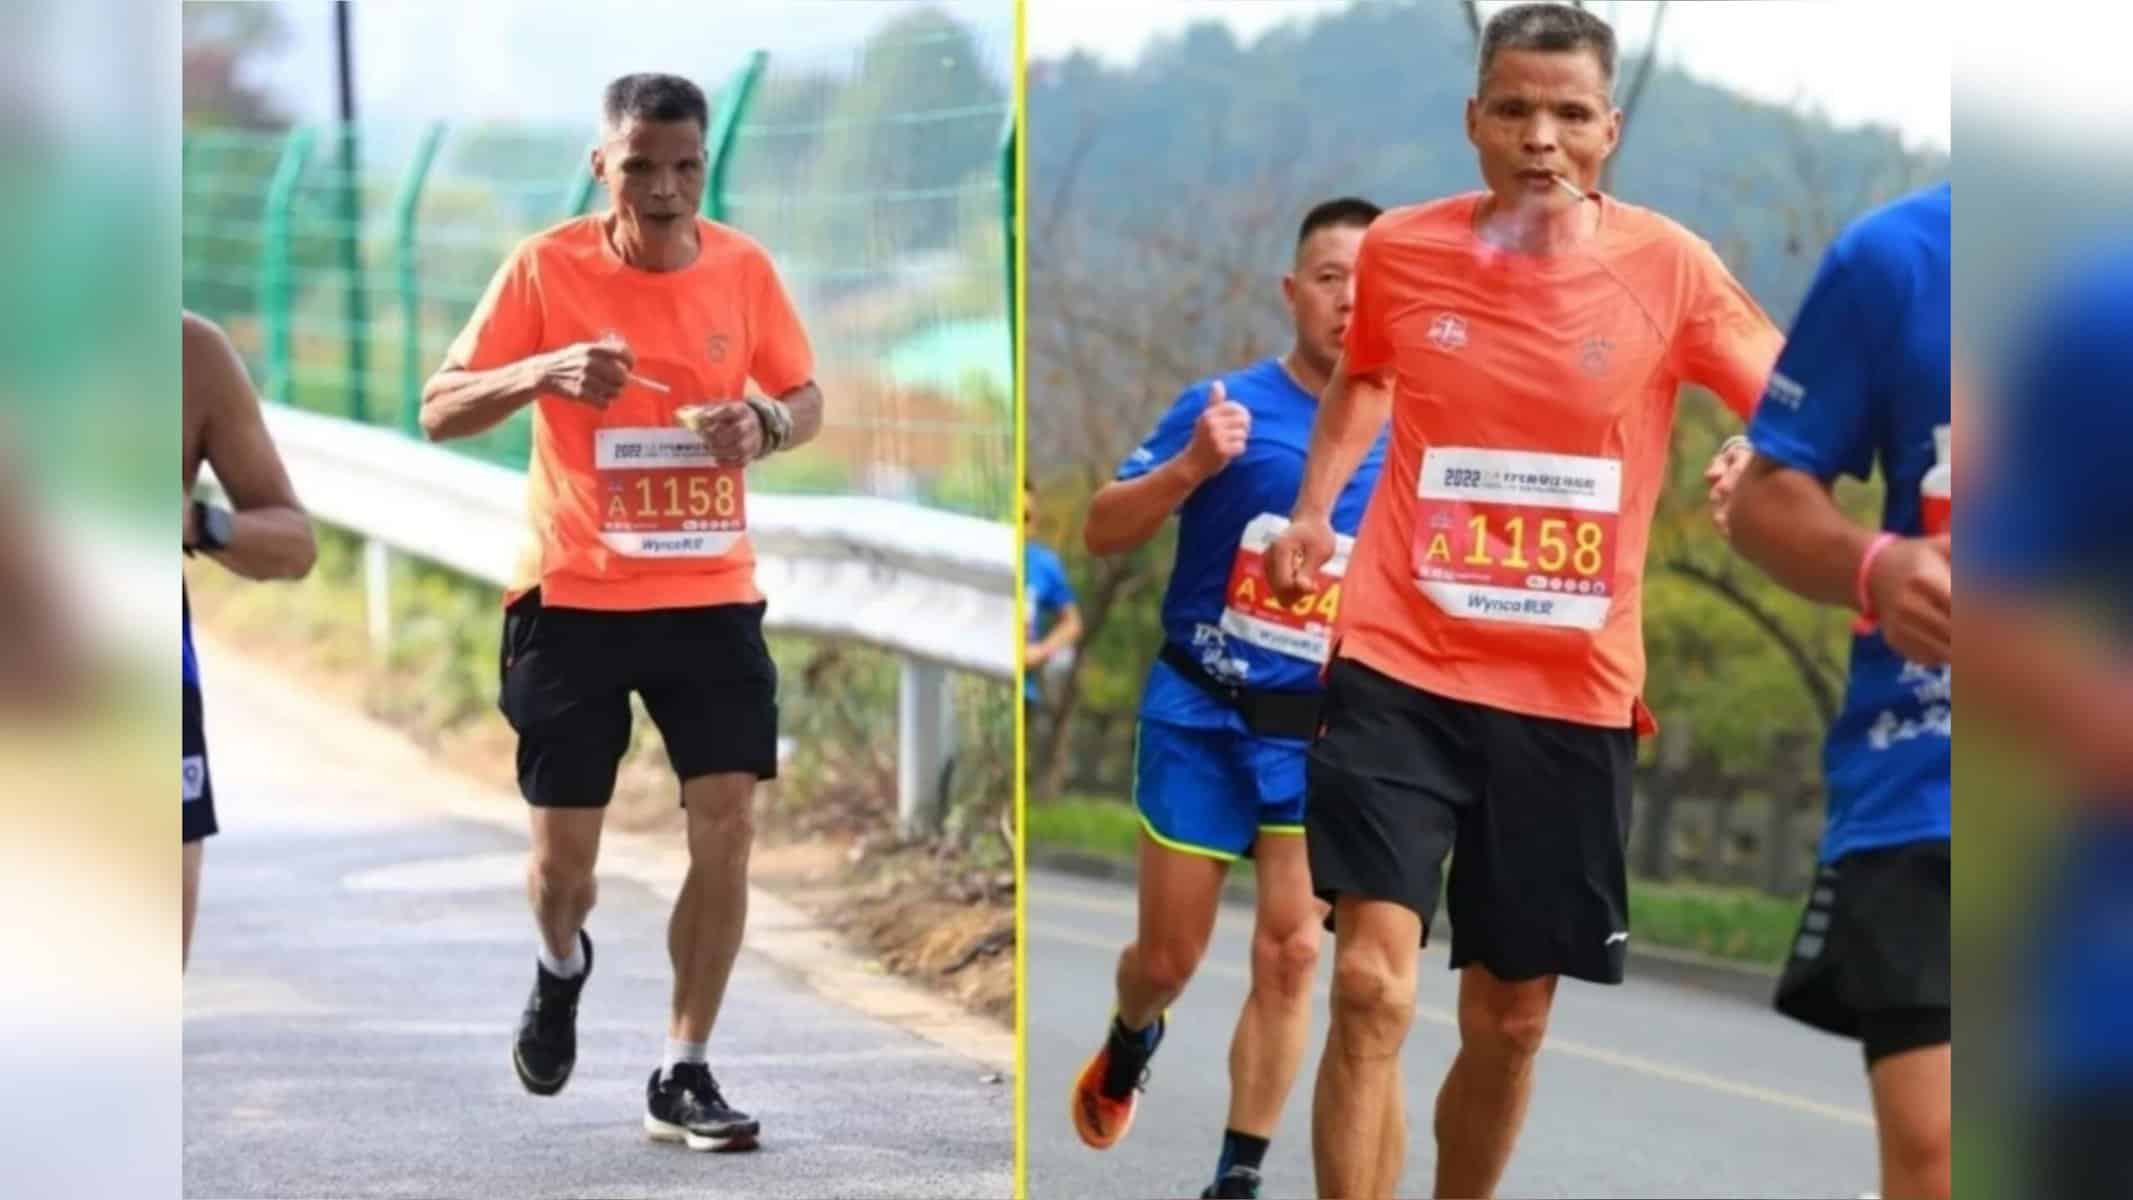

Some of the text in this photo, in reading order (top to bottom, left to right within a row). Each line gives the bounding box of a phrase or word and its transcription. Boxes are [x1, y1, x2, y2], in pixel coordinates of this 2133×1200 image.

[1444, 467, 1481, 488] 2022
[608, 475, 735, 518] A 1158
[1425, 514, 1603, 576] A 1158
[1234, 576, 1256, 603] A
